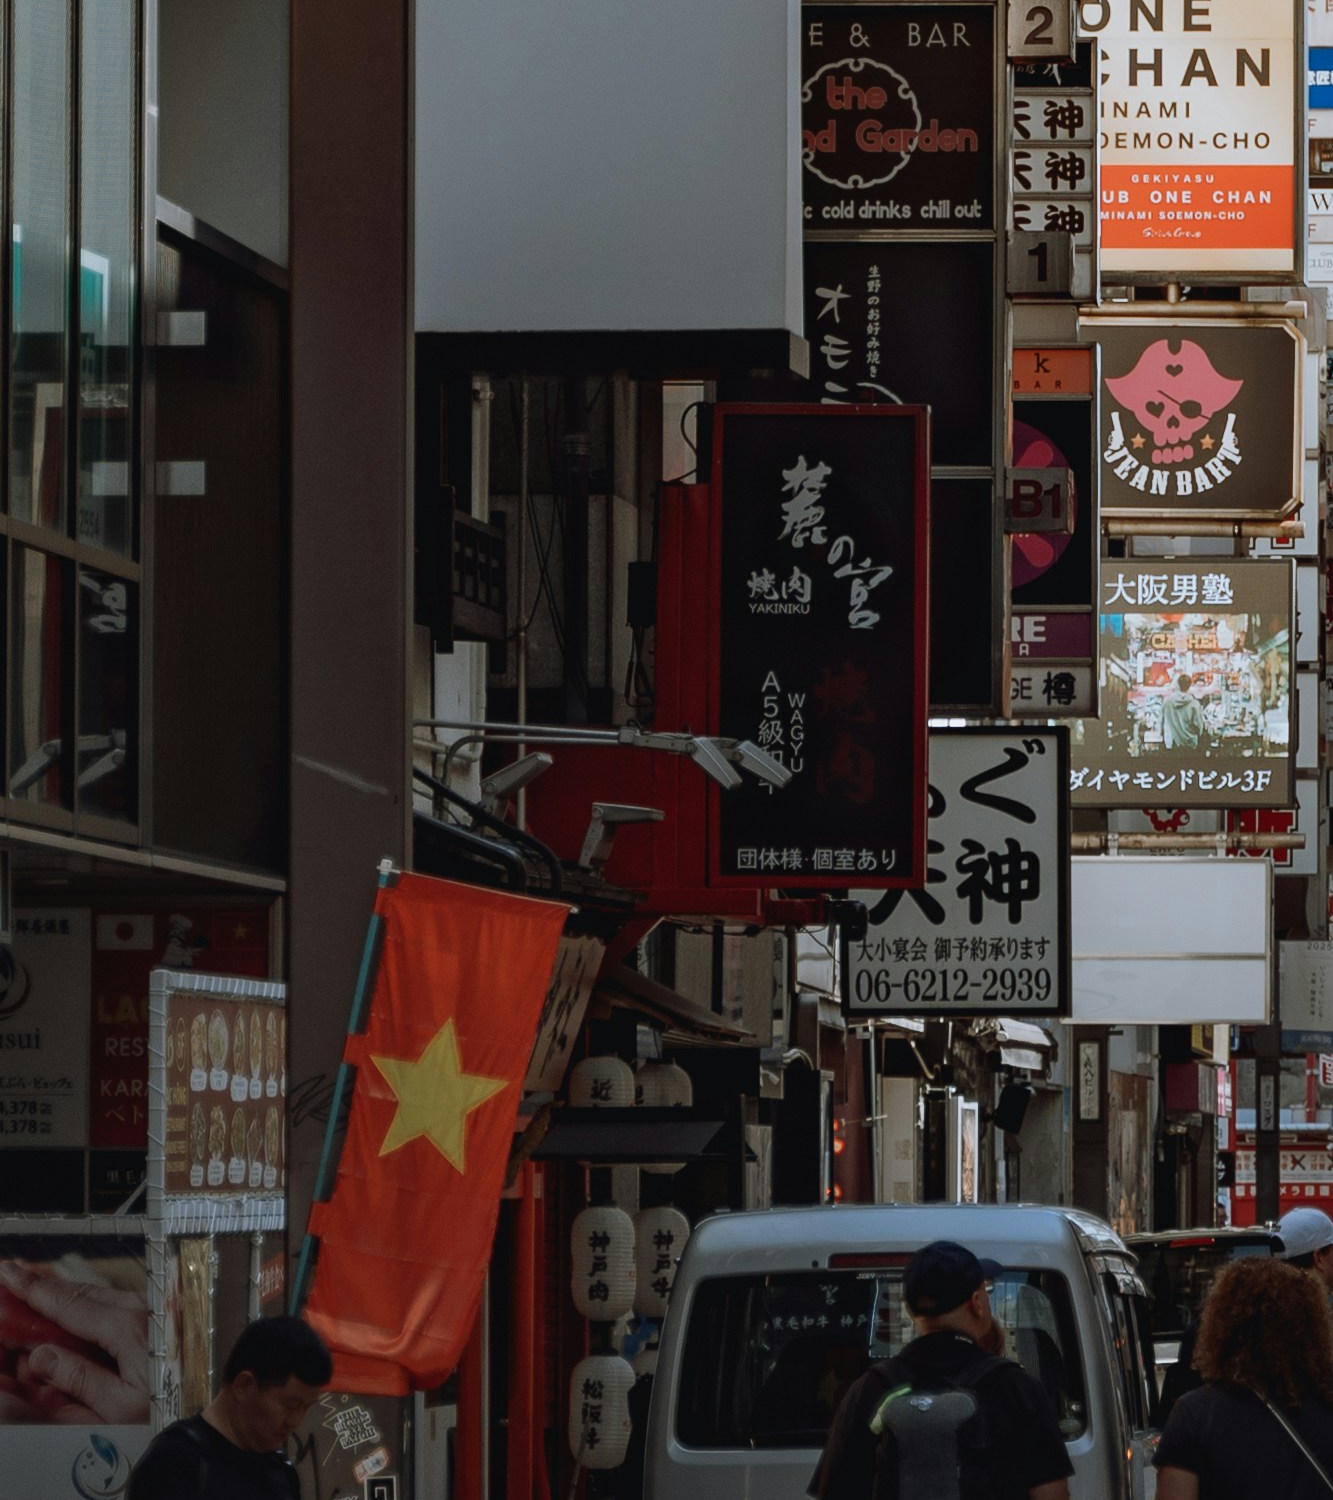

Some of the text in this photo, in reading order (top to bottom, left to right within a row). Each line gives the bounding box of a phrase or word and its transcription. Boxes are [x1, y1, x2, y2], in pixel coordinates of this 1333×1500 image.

[908, 22, 971, 47] BAR
[1024, 5, 1054, 46] 2
[826, 76, 888, 110] the
[855, 119, 979, 152] Garden
[1131, 174, 1215, 183] GEKIYASU
[822, 199, 982, 219] cold drinks chill out
[1149, 190, 1272, 204] ONE CHAN
[1158, 210, 1245, 221] SOEMON-CHO
[1027, 241, 1048, 282] 1
[1104, 439, 1244, 496] JEAN BART
[1012, 478, 1062, 519] B1
[747, 566, 812, 603] 焼肉
[1104, 573, 1234, 606] 大阪男塾
[748, 603, 811, 615] YAKINIKU
[788, 692, 806, 773] WAGYU
[1068, 767, 1272, 793] ダイヤモンドビル3F
[856, 935, 1051, 963] 大小宴会 御予約承ります
[854, 967, 1052, 1002] 06-6212-2939
[588, 1230, 611, 1302] 神戸肉
